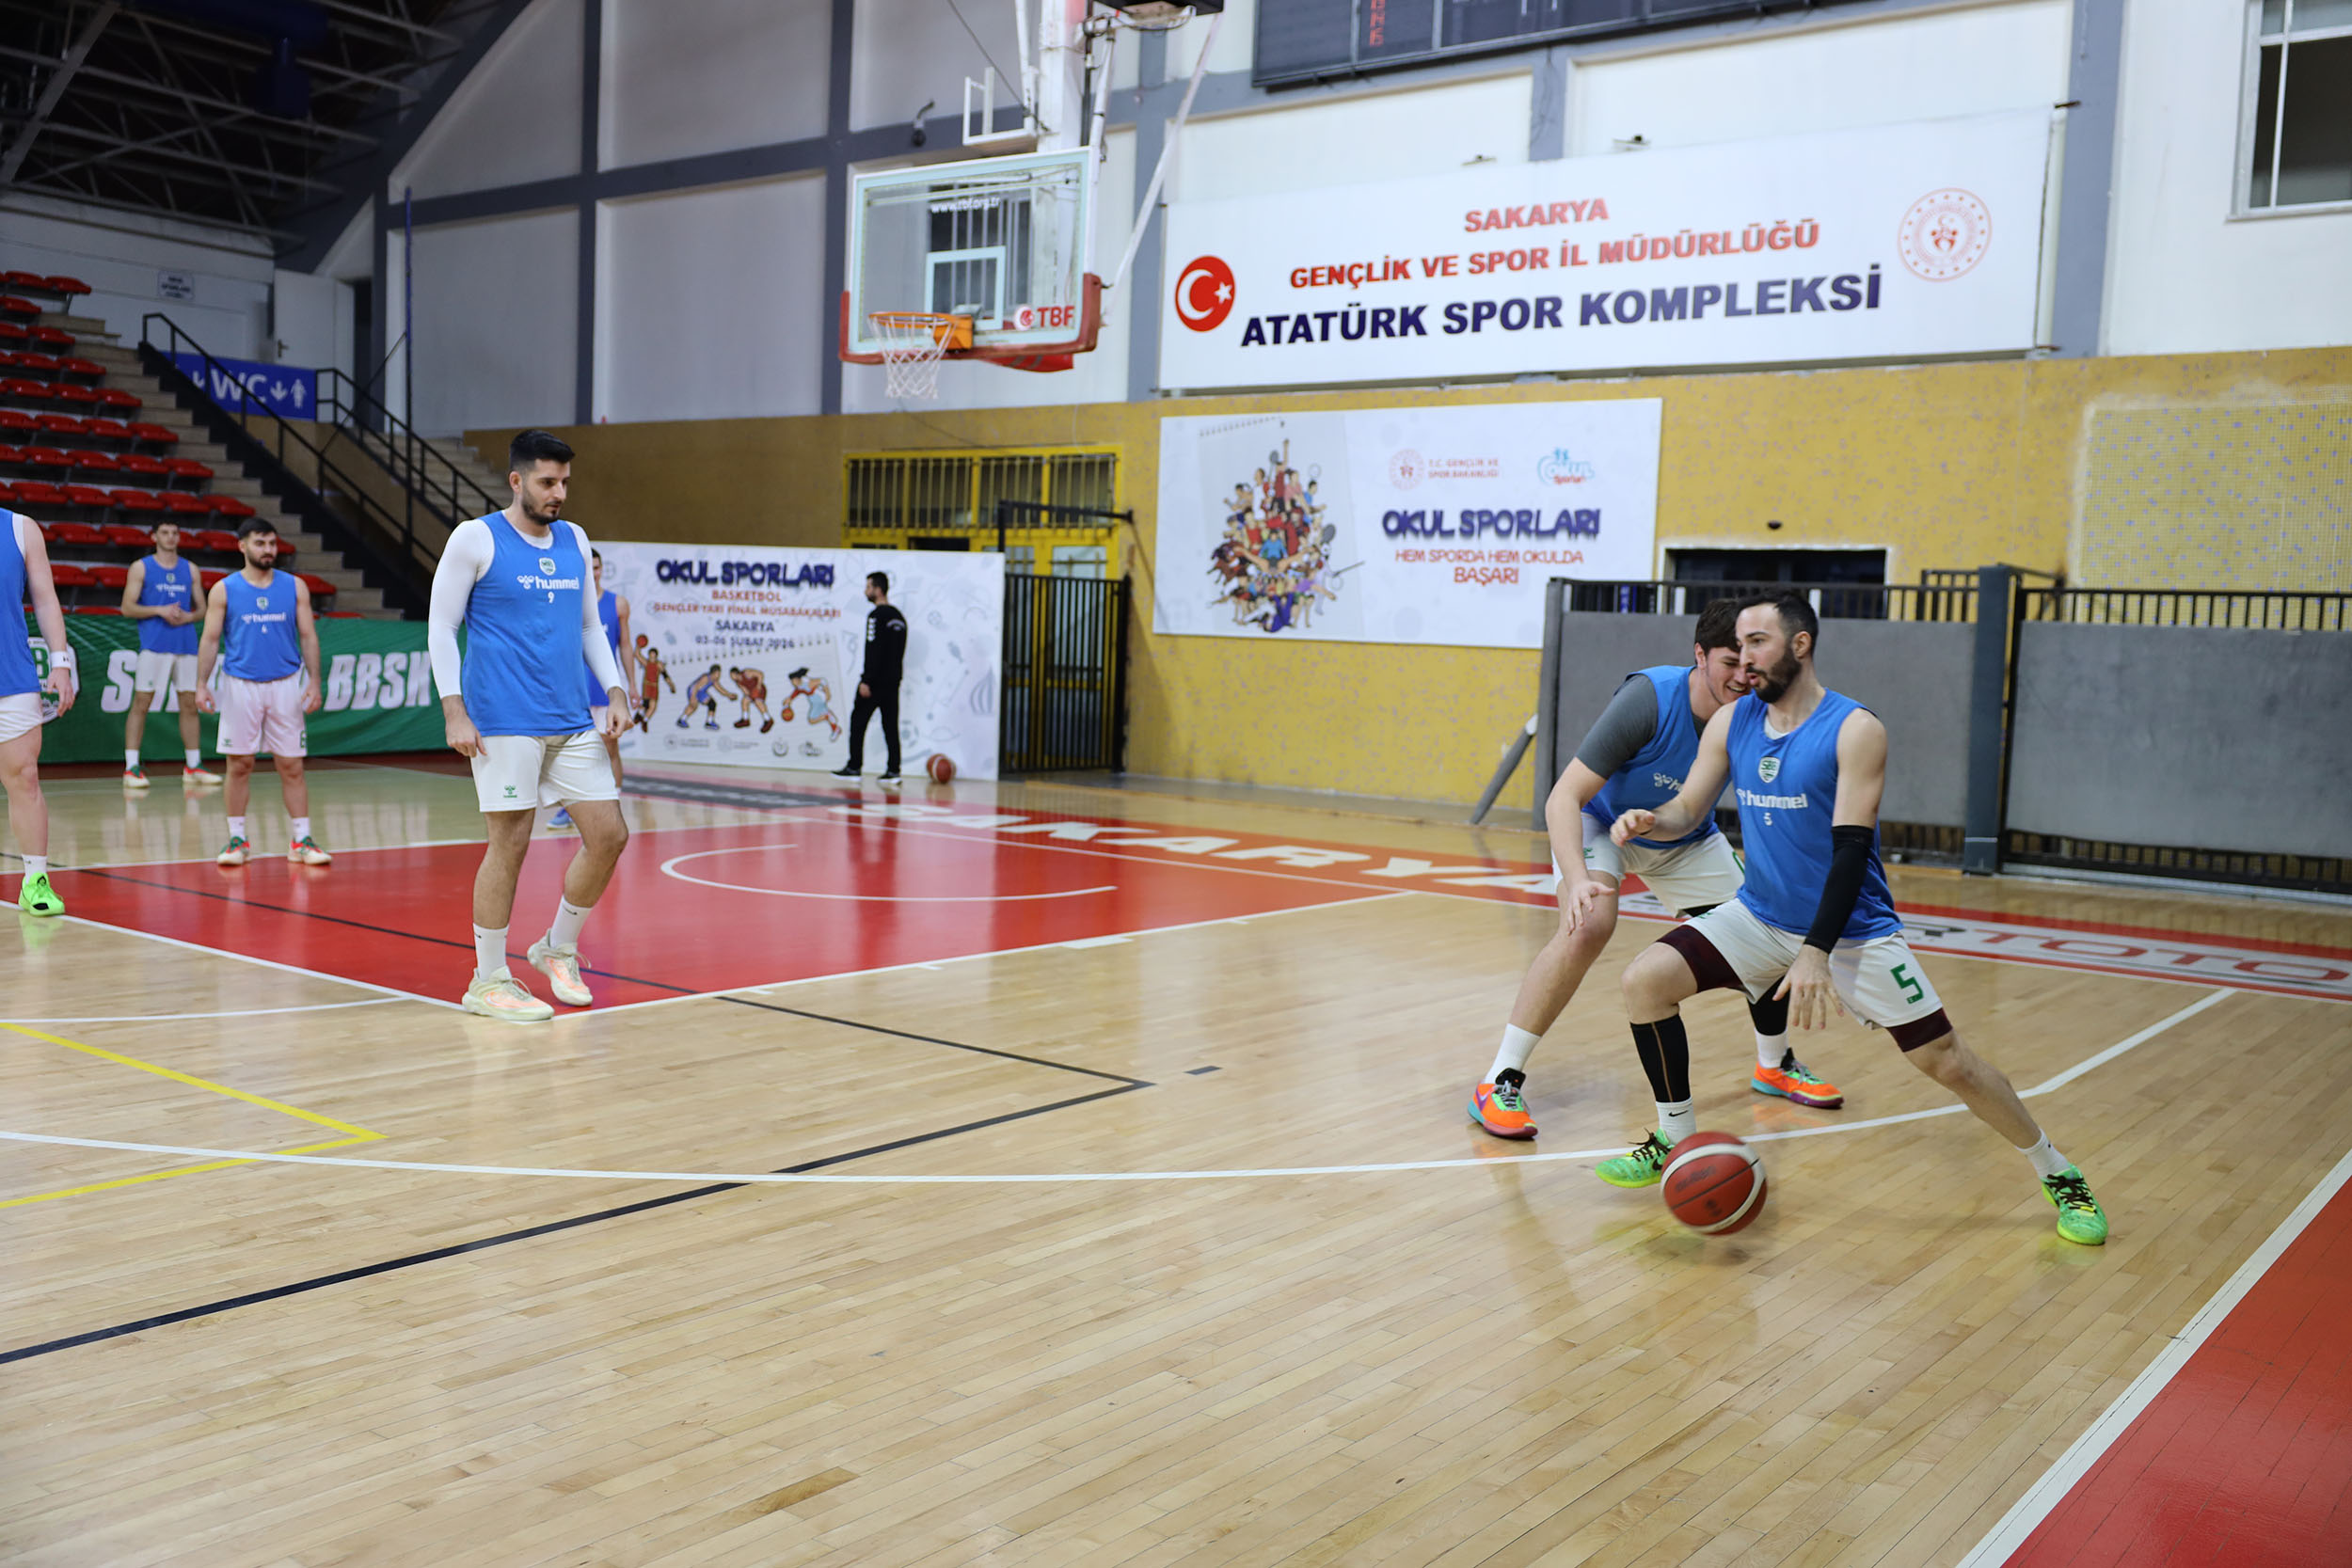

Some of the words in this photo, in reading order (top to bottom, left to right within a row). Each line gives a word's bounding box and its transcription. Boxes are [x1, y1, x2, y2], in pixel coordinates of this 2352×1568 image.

[1464, 198, 1609, 233] SAKARYA
[1290, 255, 1412, 289] GENÇLİK
[1422, 255, 1459, 277] VE
[1468, 247, 1549, 275] SPOR
[1559, 239, 1589, 268] İL
[1597, 217, 1820, 264] MÜDÜRLÜĞÜ
[1037, 306, 1074, 327] TBF
[1241, 303, 1428, 347] ATATÜRK
[1442, 296, 1563, 335] SPOR
[1580, 263, 1882, 326] KOMPLEKSİ
[211, 368, 267, 403] WC
[1382, 509, 1454, 539] OKUL
[1459, 509, 1600, 540] SPORLARI
[1395, 549, 1425, 562] HEM
[1428, 549, 1486, 563] SPORDA
[1488, 549, 1520, 563] HEM
[1522, 550, 1584, 564] OKULDA
[535, 576, 580, 590] hummel
[657, 561, 718, 585] OKUL
[722, 562, 834, 588] SPORLARI
[1454, 566, 1519, 586] BAŞARI
[548, 591, 555, 604] 9
[712, 590, 782, 602] BASKETBOL
[715, 620, 774, 632] SAKARYA
[1746, 790, 1808, 809] hummel
[1763, 812, 1773, 826] 5
[827, 803, 1559, 895] SAKARYA
[1972, 927, 2350, 982] TOTO
[1890, 963, 1924, 1004] 5
